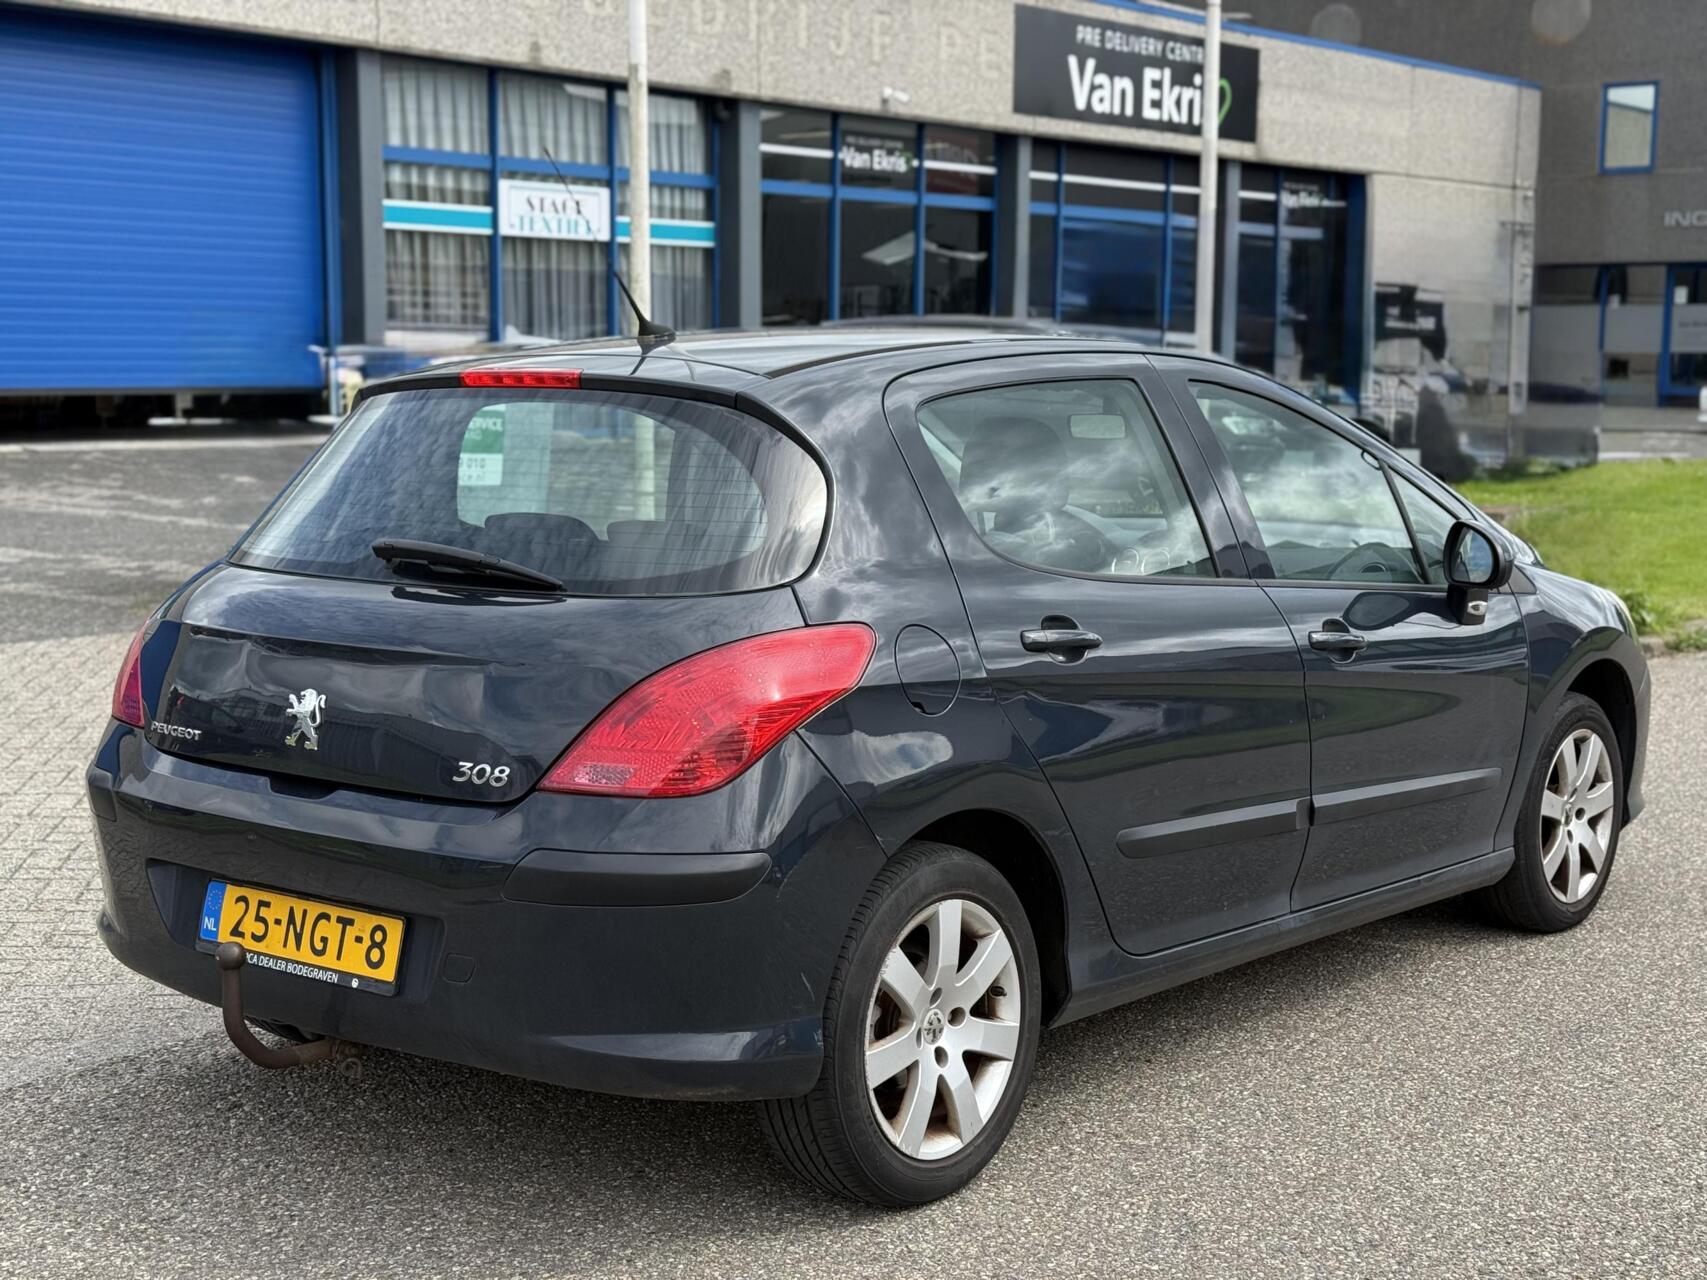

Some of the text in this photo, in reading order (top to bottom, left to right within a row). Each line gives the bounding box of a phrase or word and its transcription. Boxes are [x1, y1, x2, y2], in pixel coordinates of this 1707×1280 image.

[1076, 24, 1205, 64] PRE DELIVERY CENTR
[1067, 54, 1205, 126] Van Ekri
[841, 145, 871, 168] Van
[150, 720, 202, 740] PEUGEOT
[452, 761, 511, 788] 308
[203, 916, 217, 932] NL
[229, 895, 388, 970] 25-NGT-8
[259, 955, 287, 973] DEALER
[286, 962, 339, 984] BODEGRAVEN
